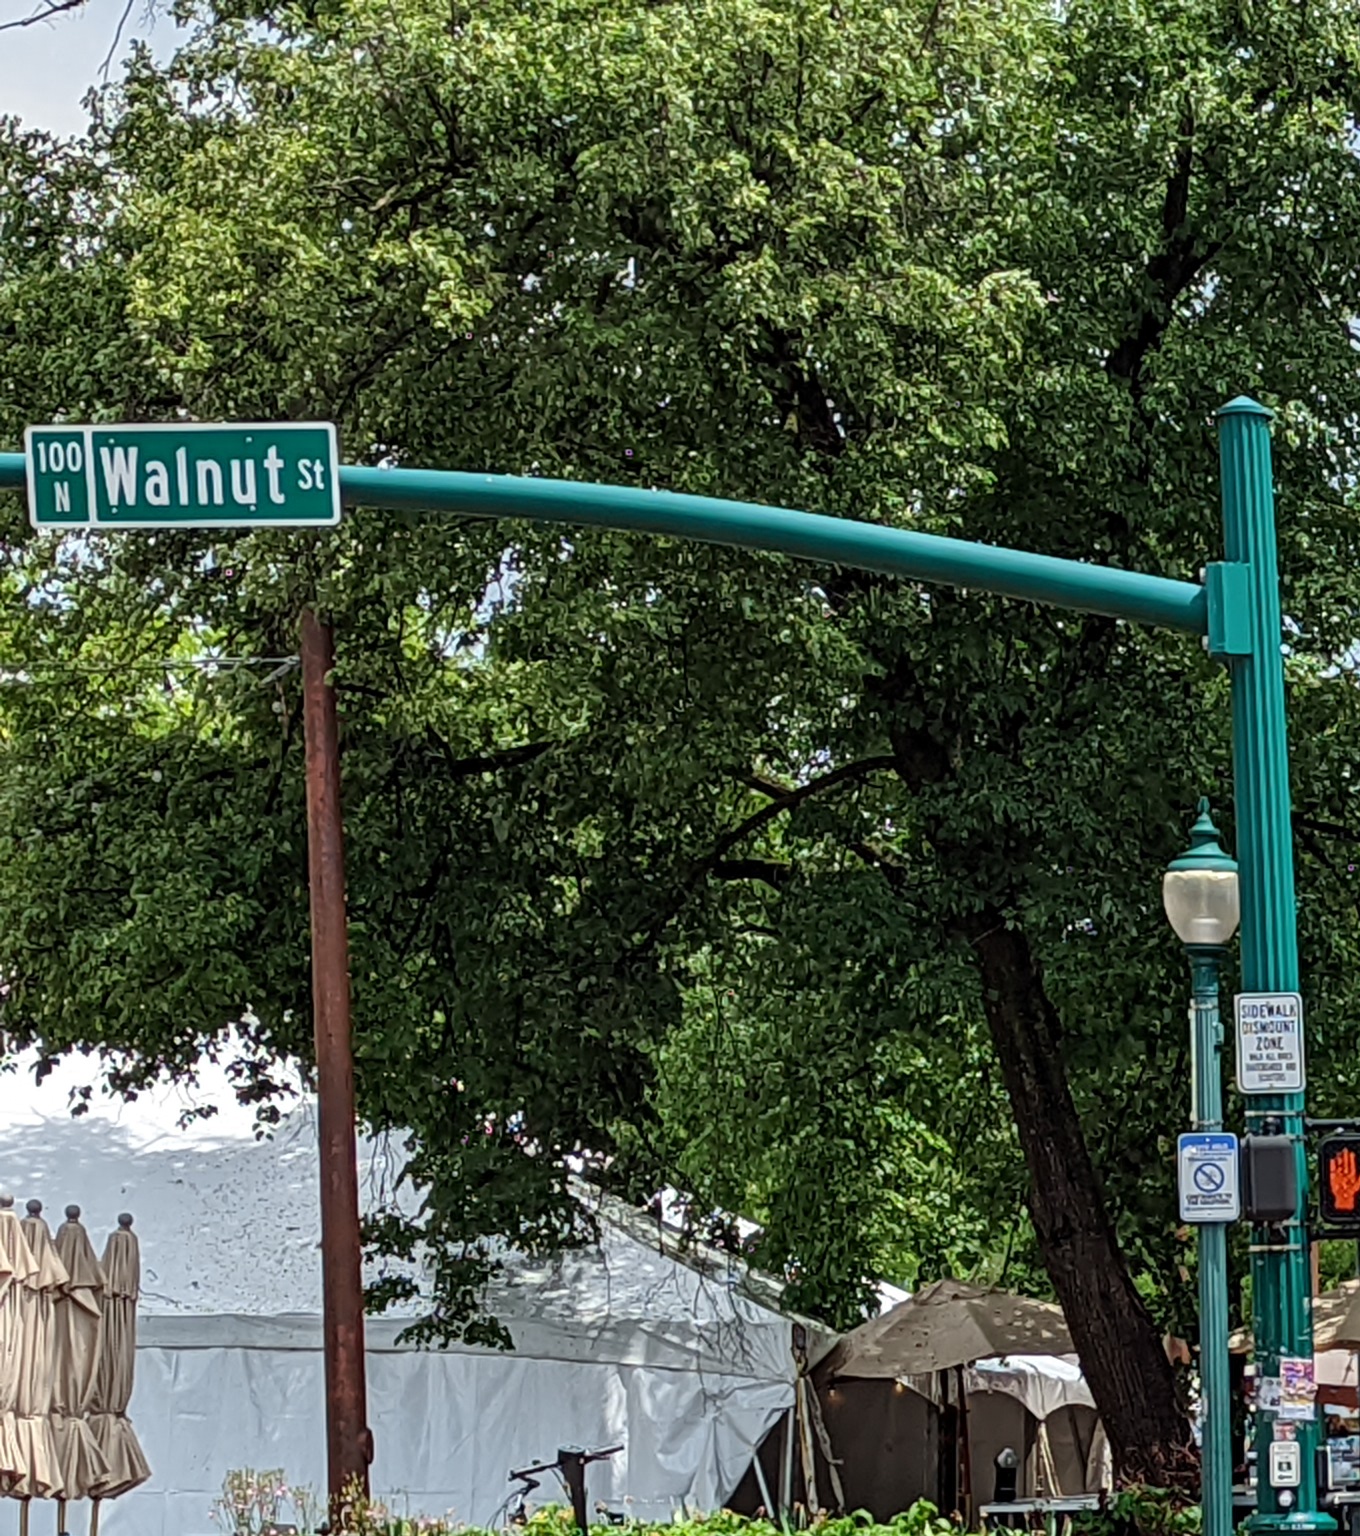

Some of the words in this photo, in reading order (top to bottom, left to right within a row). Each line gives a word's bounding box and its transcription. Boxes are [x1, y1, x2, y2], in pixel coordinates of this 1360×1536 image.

[37, 441, 82, 474] 100
[99, 445, 286, 506] Walnut
[298, 457, 325, 491] St
[54, 481, 72, 513] N
[1241, 1003, 1297, 1018] SIDEWALK
[1241, 1020, 1295, 1035] DISMOUNT
[1255, 1036, 1285, 1051] ZONE
